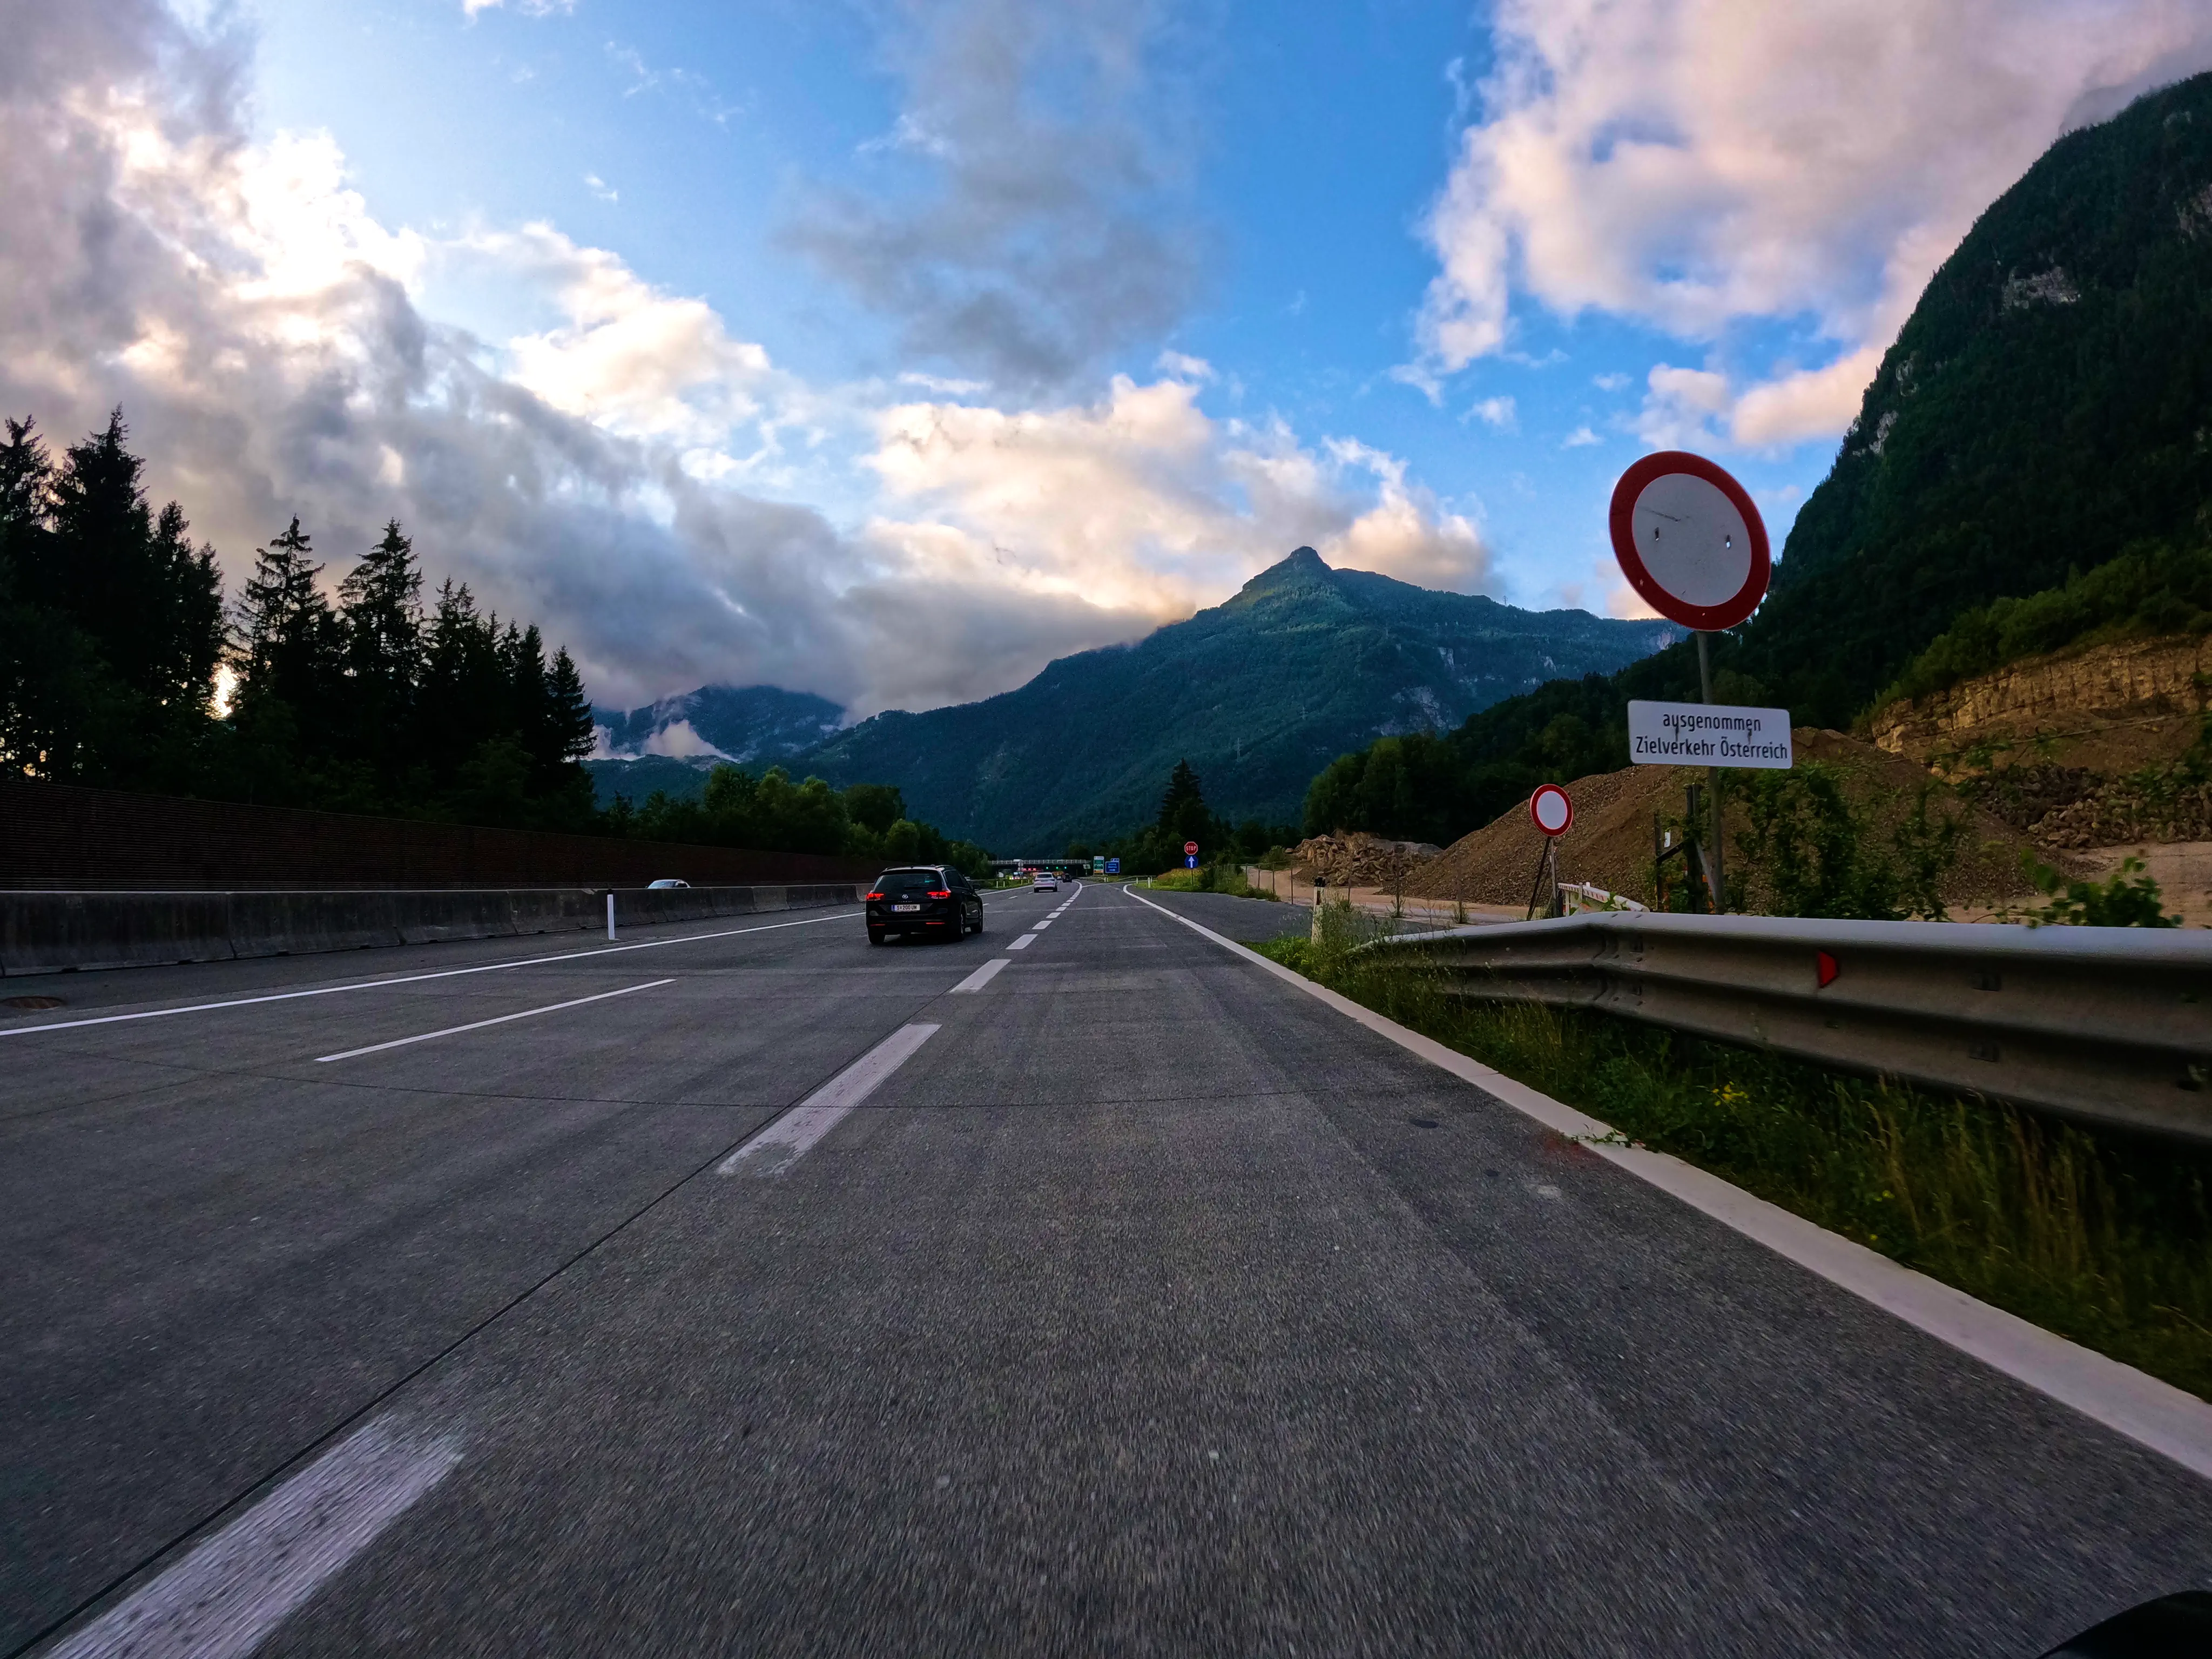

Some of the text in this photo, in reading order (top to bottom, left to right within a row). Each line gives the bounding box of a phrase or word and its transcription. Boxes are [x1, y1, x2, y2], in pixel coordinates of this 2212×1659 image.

[1663, 713, 1761, 731] ausgenommen
[1636, 736, 1788, 759] Zielverkehr Österreich
